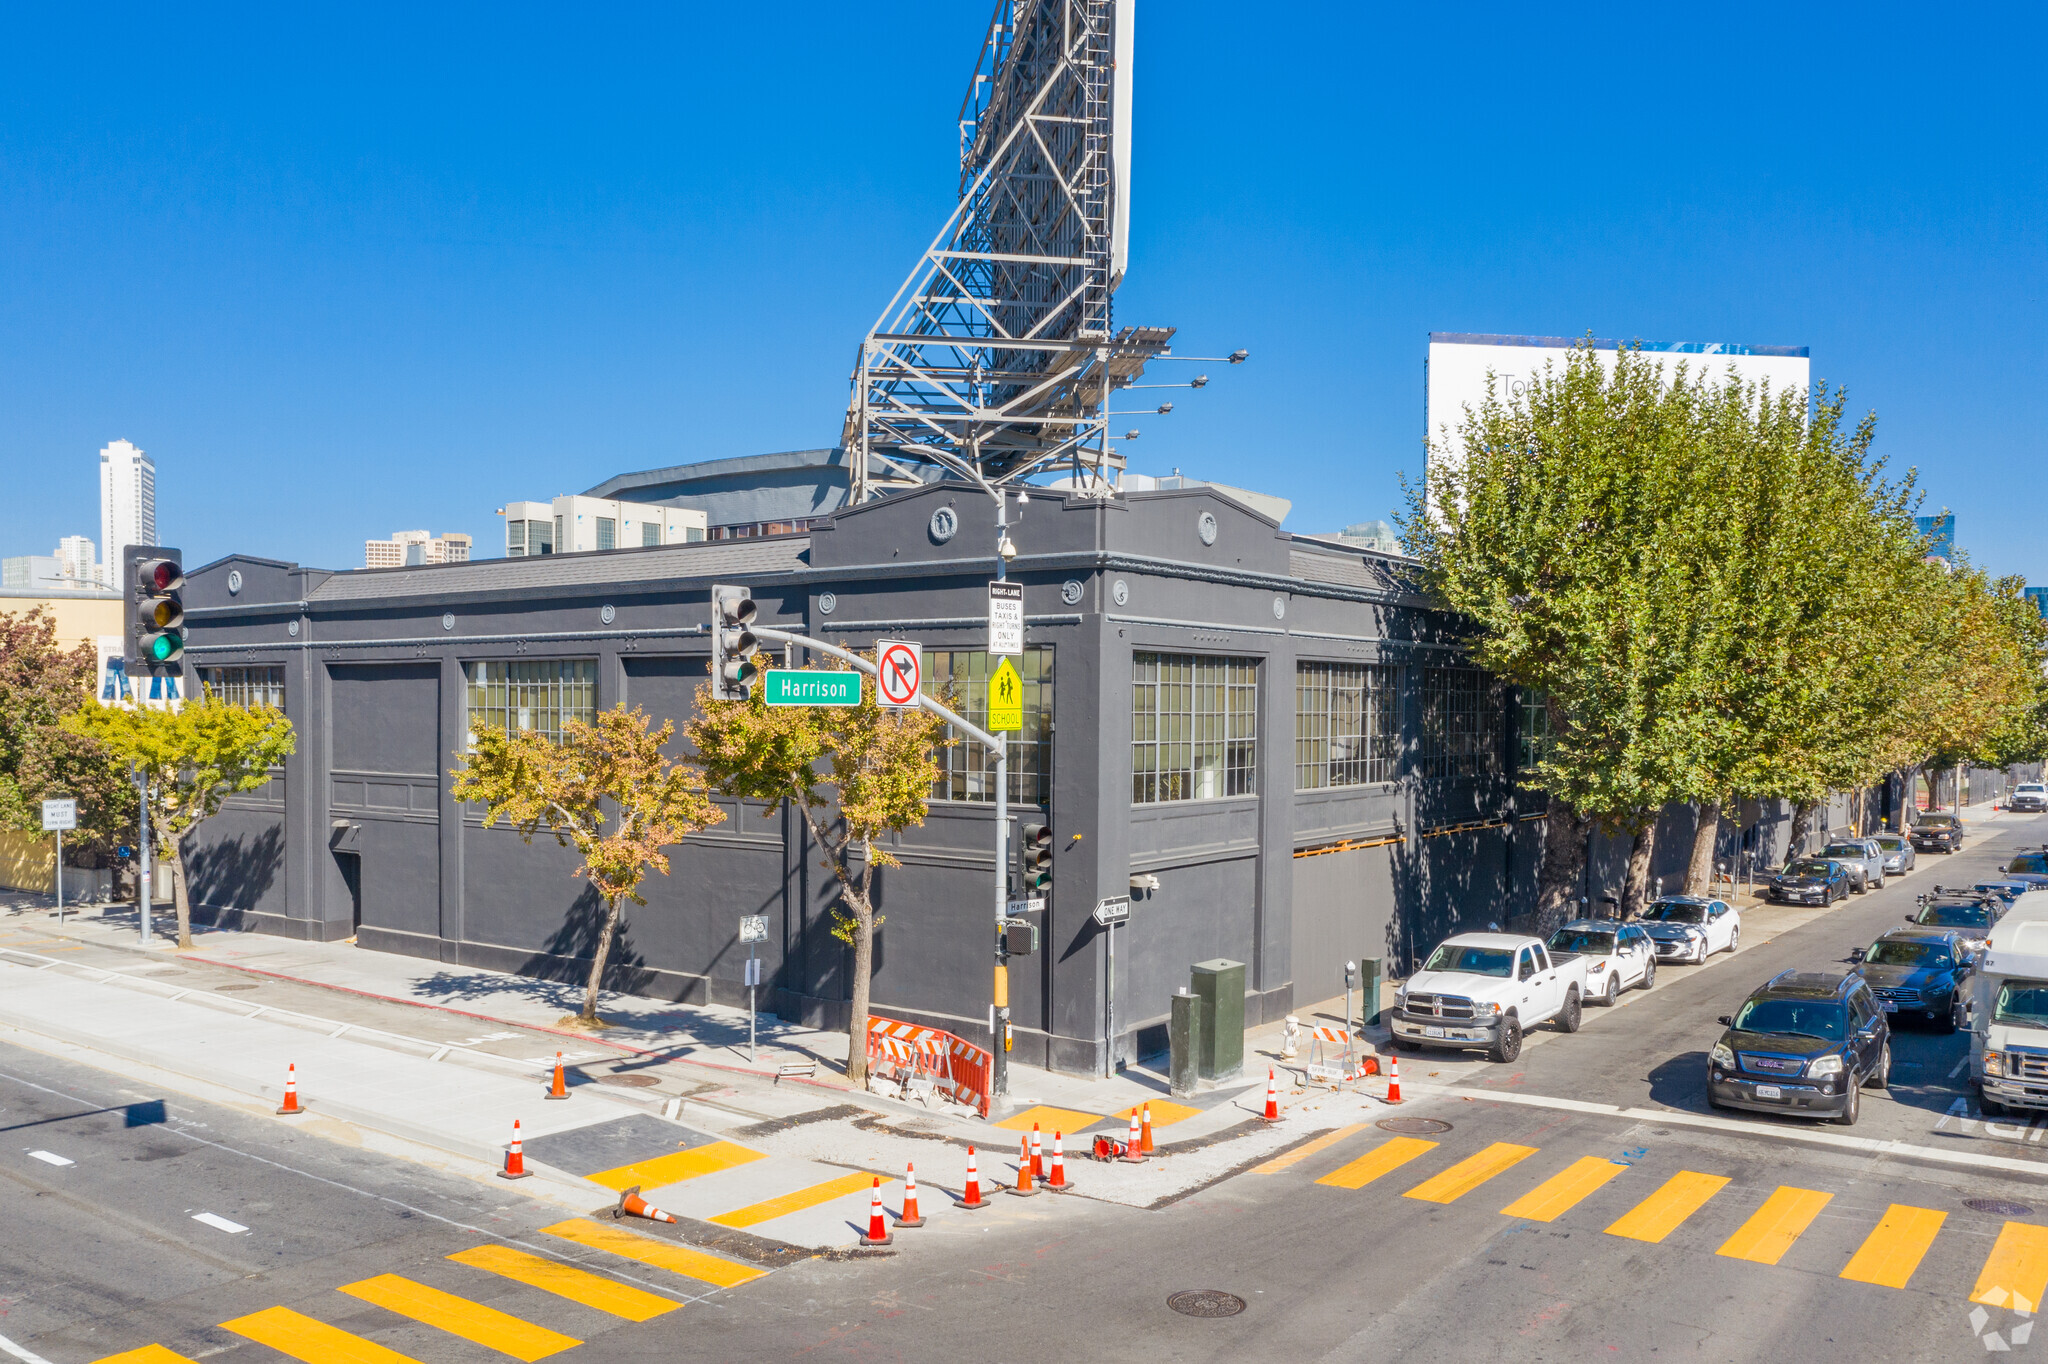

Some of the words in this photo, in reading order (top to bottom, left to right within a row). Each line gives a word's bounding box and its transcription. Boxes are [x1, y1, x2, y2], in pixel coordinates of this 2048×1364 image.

[992, 587, 1006, 596] RIGHT
[1007, 588, 1021, 597] LANE
[996, 602, 1017, 611] BUSES
[994, 611, 1013, 620] TAXIS
[992, 621, 1006, 629] RIGHT
[1006, 622, 1021, 631] TURNS
[997, 631, 1015, 640] ONLY
[781, 679, 847, 697] Harrison
[992, 713, 1020, 725] SCHOOL
[1011, 901, 1040, 911] Harrison
[1104, 907, 1115, 917] ONE
[1116, 904, 1127, 914] WAY
